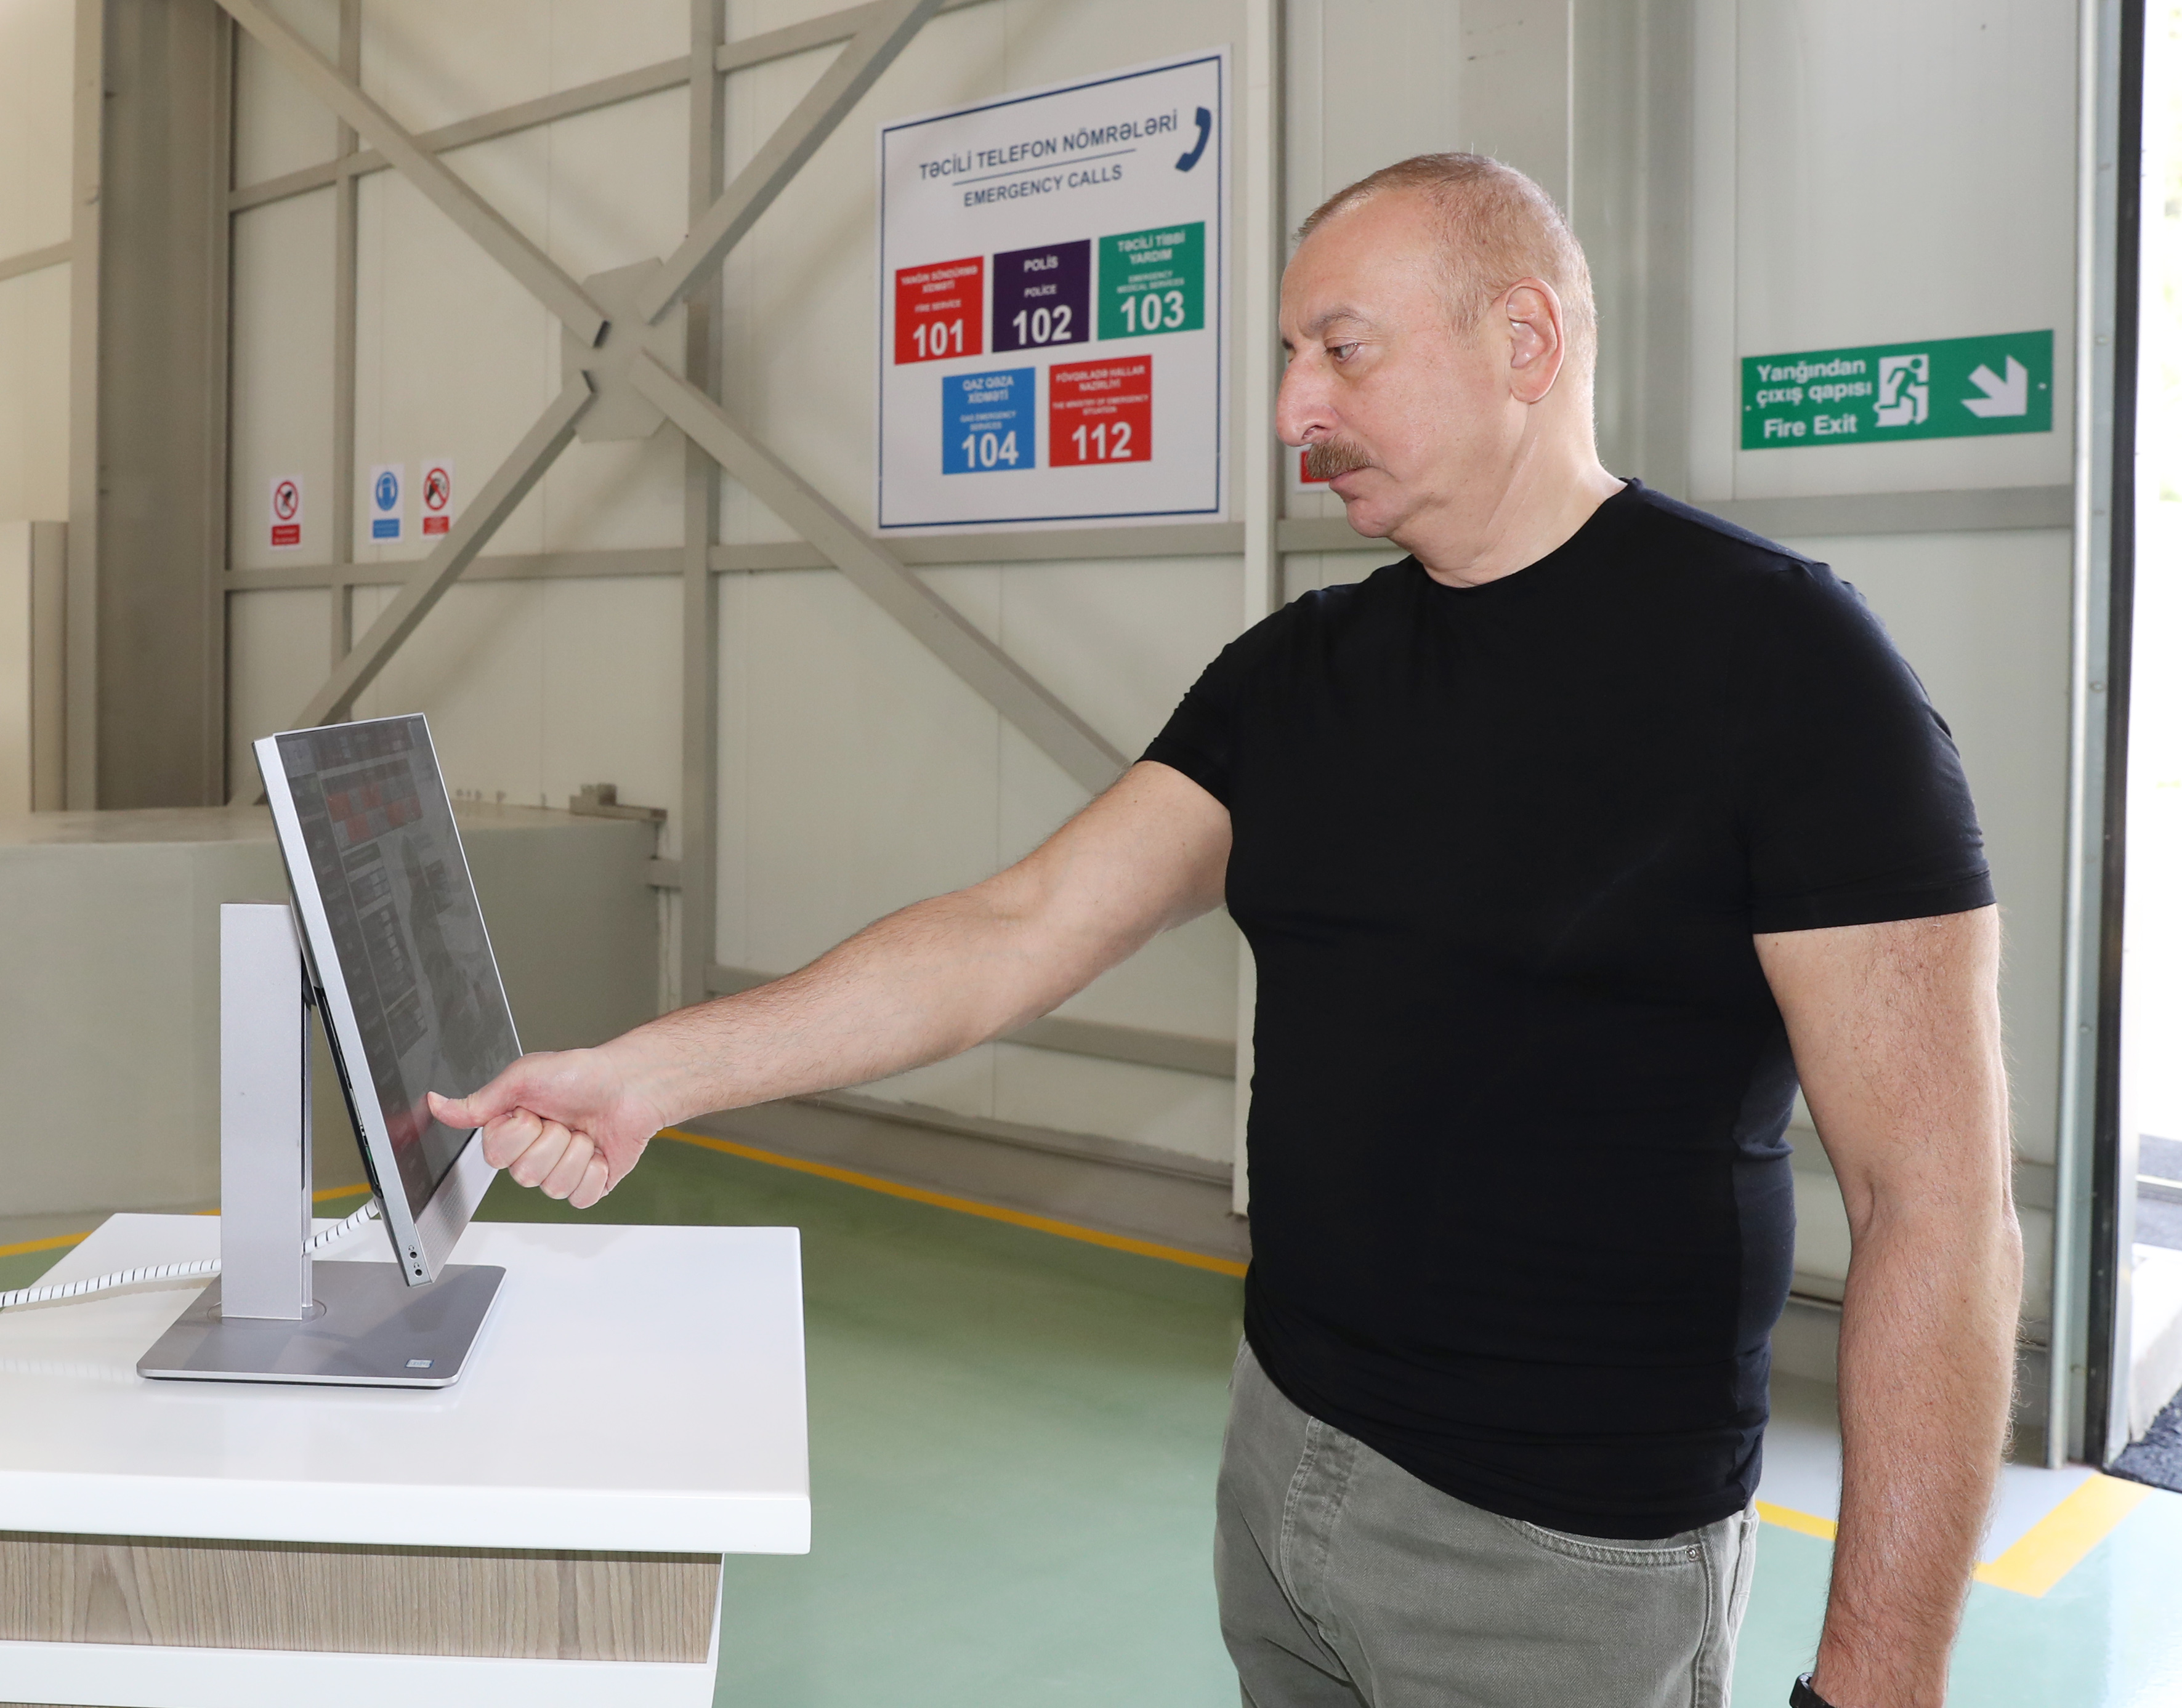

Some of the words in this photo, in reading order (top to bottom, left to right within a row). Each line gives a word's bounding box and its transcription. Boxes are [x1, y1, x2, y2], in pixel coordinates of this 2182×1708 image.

[919, 151, 972, 180] TƏCİLİ
[978, 139, 1057, 169] TELEFON
[1063, 109, 1178, 152] NÖMRƏLƏRİ
[964, 177, 1062, 207] EMERGENCY
[1068, 164, 1123, 188] CALLS
[1024, 254, 1059, 273] POLİS
[1012, 304, 1072, 345] 102
[1120, 290, 1186, 333] 103
[913, 318, 964, 358] 101
[1756, 358, 1866, 383] Yanğından
[1756, 387, 1803, 409] çıxış
[1808, 382, 1872, 403] qapısı
[1072, 421, 1132, 461] 112
[1764, 417, 1806, 438] Fire
[1813, 413, 1857, 435] Exit
[961, 430, 1019, 469] 104
